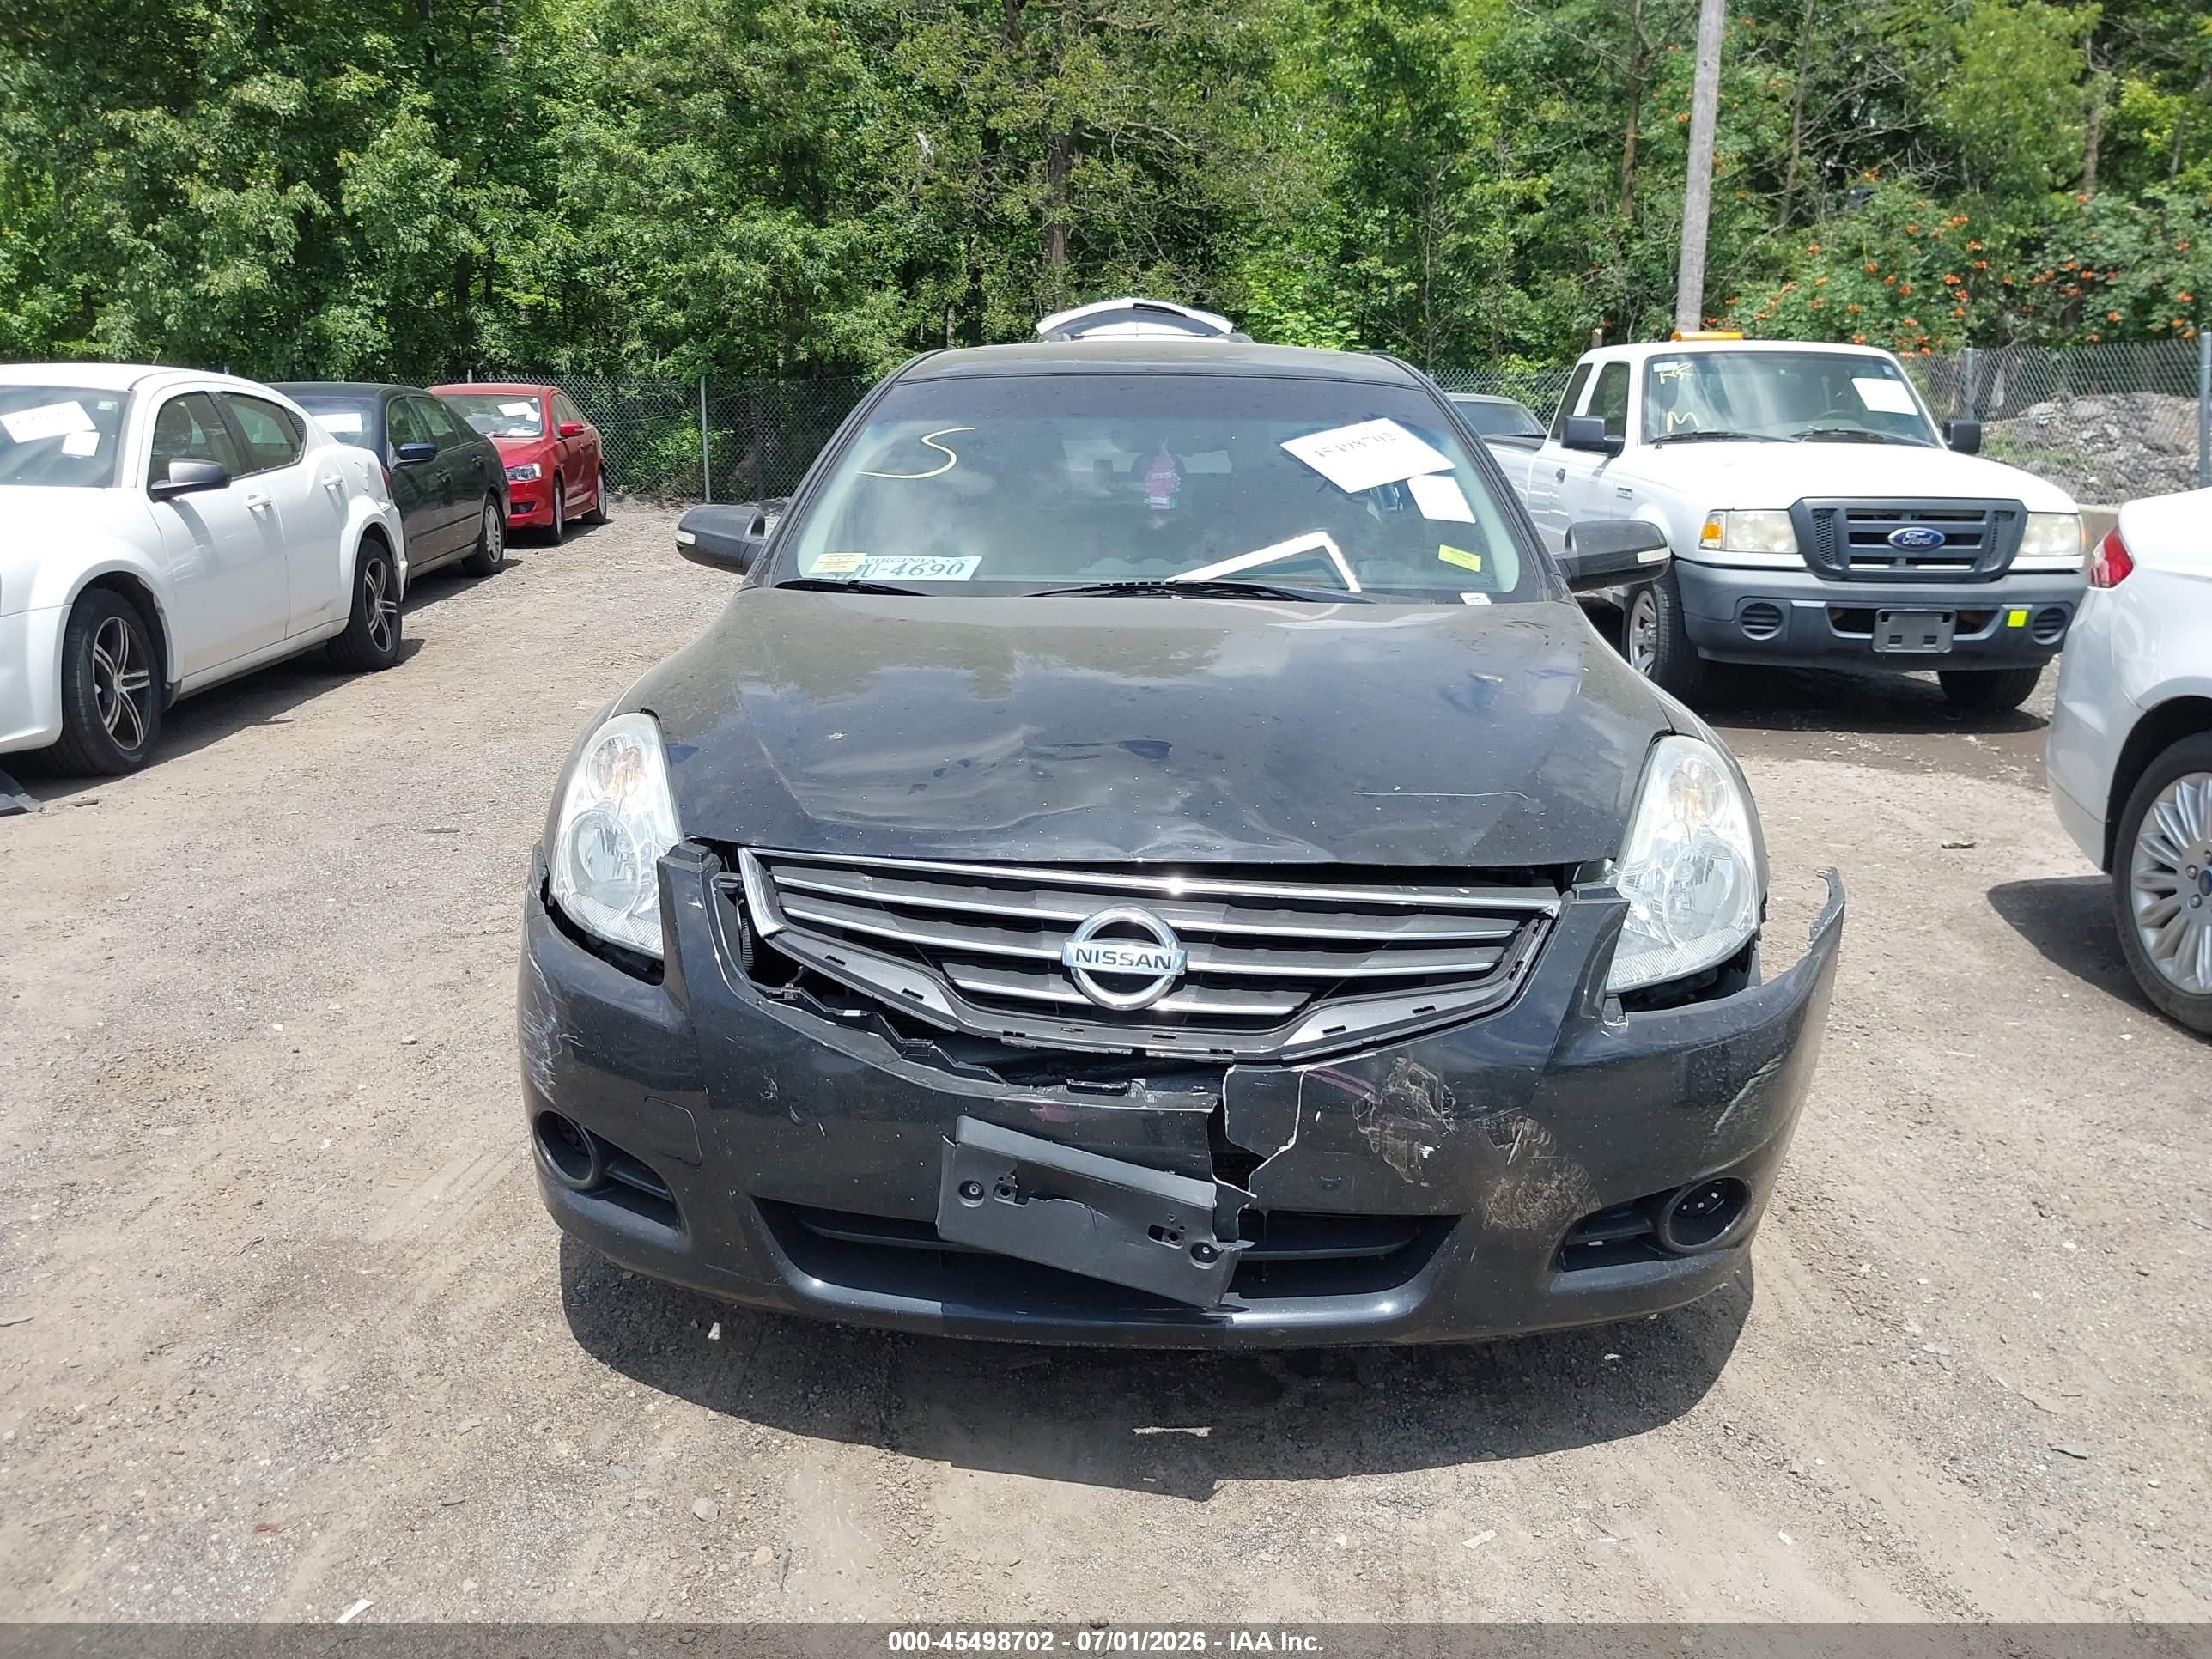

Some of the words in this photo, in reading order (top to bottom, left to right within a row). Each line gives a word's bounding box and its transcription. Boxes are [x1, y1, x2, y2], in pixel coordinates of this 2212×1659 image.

[856, 426, 975, 479] S
[1902, 532, 1934, 545] Ford
[1075, 948, 1172, 969] NISSAN
